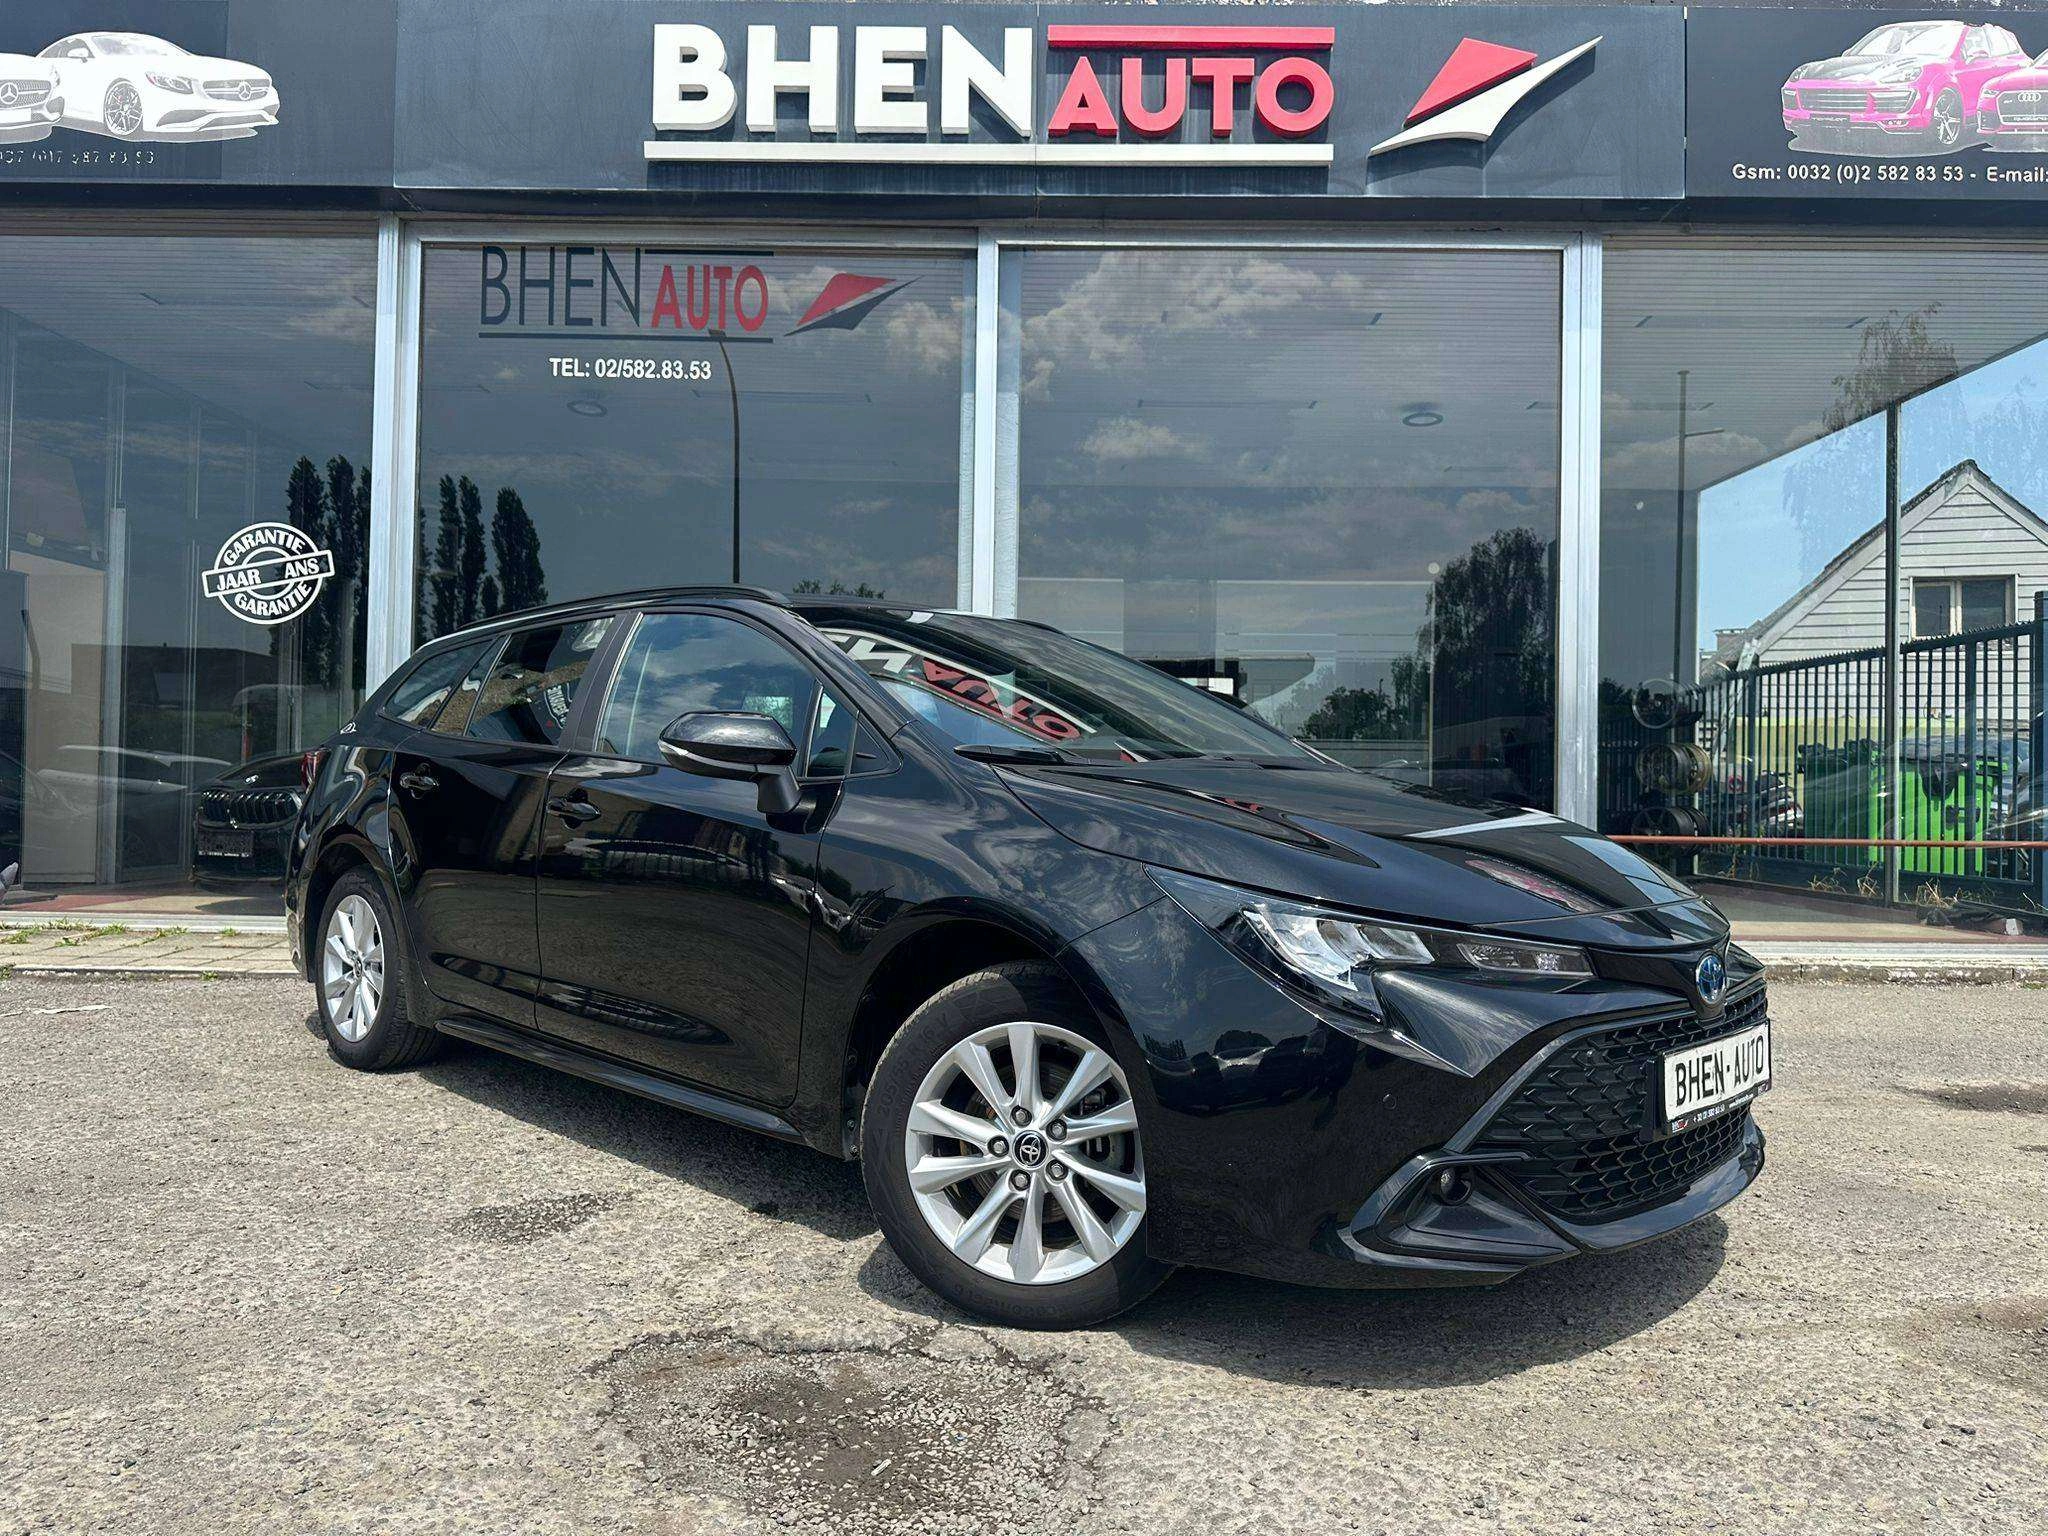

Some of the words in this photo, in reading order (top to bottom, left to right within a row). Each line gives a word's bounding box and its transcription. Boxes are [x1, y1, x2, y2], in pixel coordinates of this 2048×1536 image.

[653, 24, 1032, 137] BHEN
[1048, 56, 1335, 137] AUTO
[1732, 163, 1781, 180] Gsm:
[1787, 164, 1831, 181] 0032
[1836, 164, 1871, 184] (0)2
[1877, 165, 1909, 181] 582
[1915, 165, 1937, 181] 83
[1942, 165, 1964, 181] 53
[480, 246, 641, 327] BHEN
[651, 264, 769, 332] AUTO
[549, 357, 590, 378] TEL:
[594, 358, 712, 380] 02/582.83.53
[223, 529, 306, 566] GARANTIE
[216, 568, 262, 591] JAAR
[284, 558, 320, 579] ANS
[234, 580, 312, 616] GARANTIE
